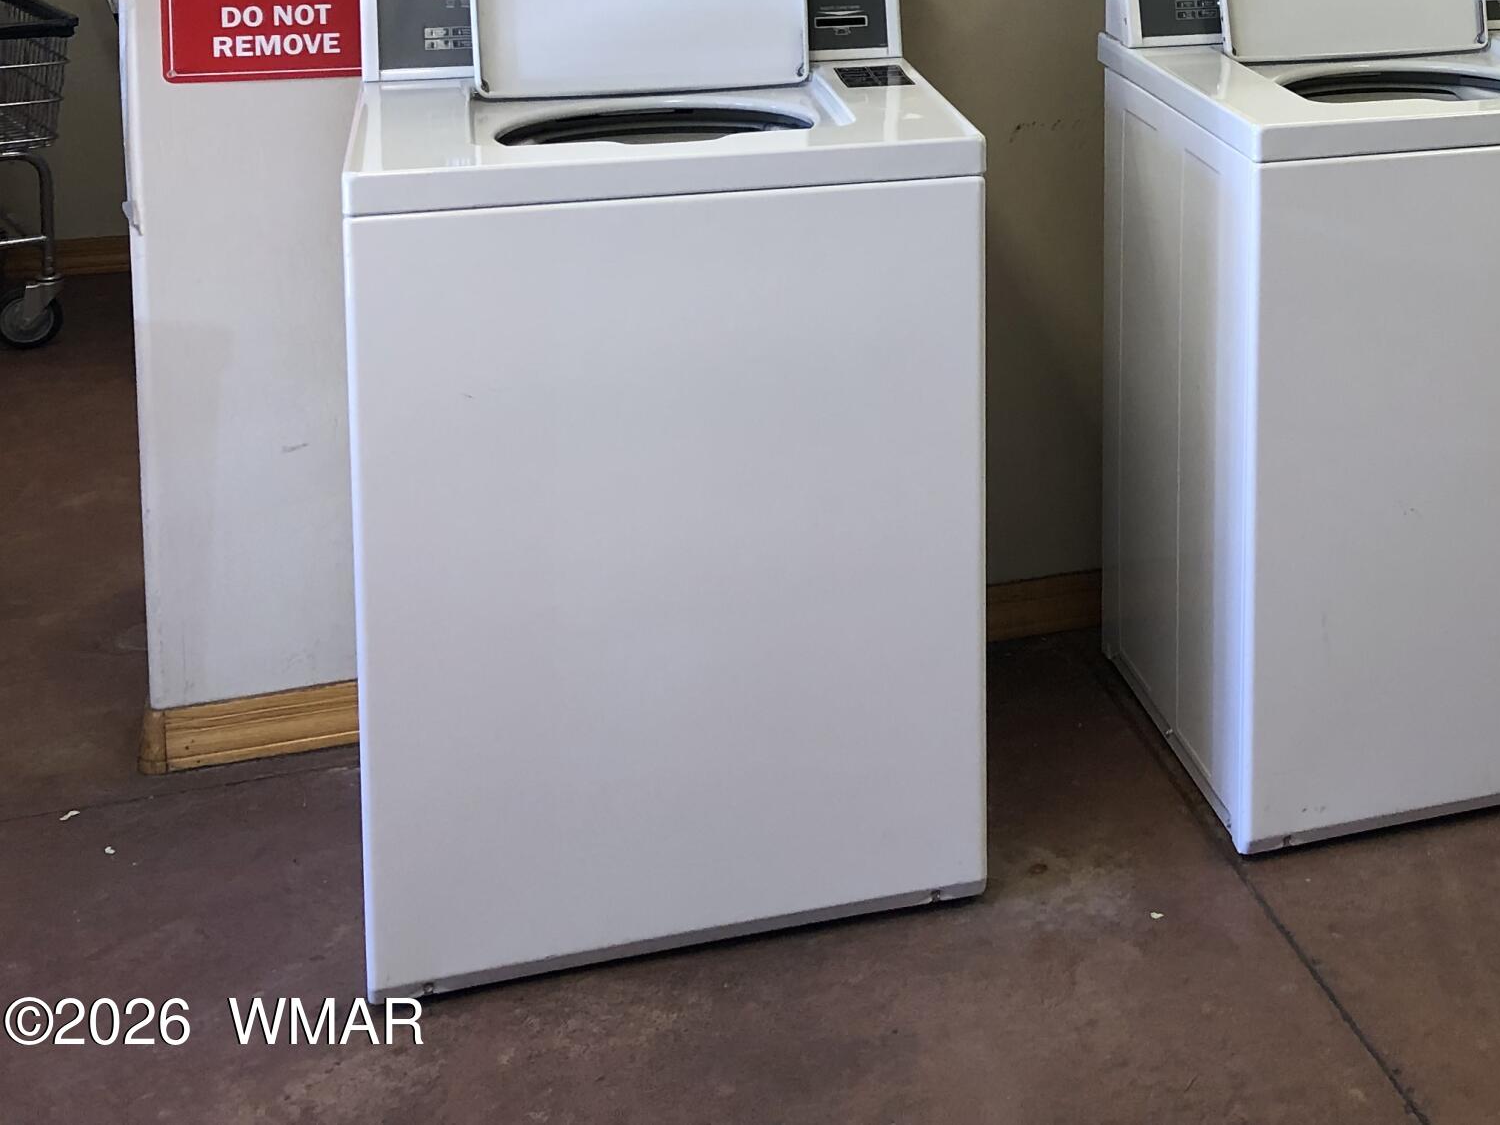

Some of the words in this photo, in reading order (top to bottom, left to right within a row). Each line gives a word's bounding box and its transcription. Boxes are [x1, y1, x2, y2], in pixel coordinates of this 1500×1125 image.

[221, 5, 264, 28] DO
[273, 3, 332, 26] NOT
[213, 32, 341, 58] REMOVE
